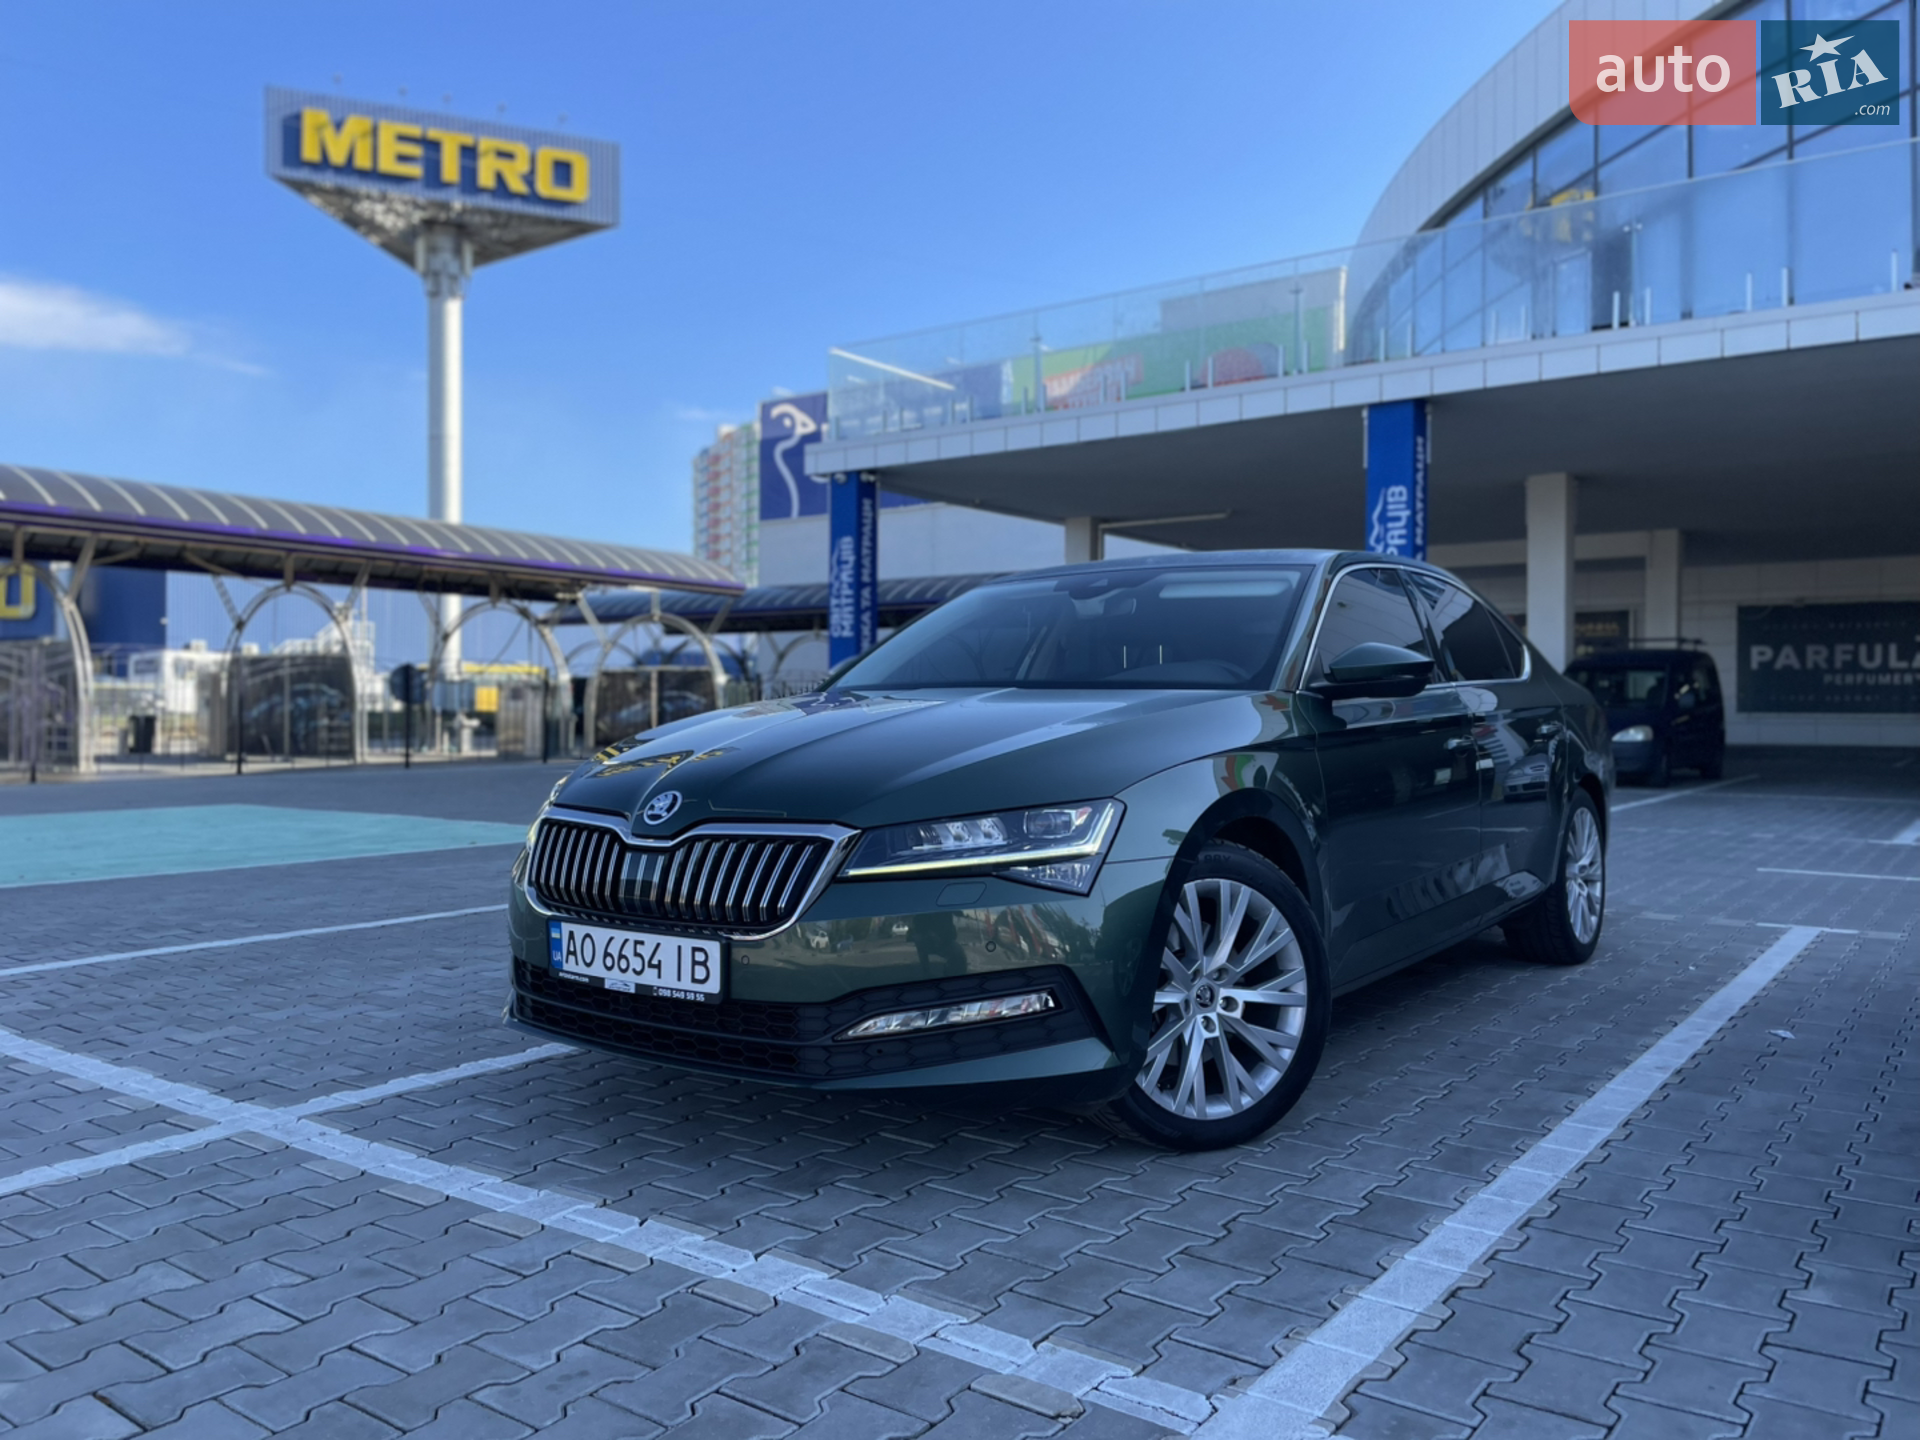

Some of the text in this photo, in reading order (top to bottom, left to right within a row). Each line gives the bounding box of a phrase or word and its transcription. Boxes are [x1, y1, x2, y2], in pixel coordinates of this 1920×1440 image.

[301, 107, 590, 204] METRO
[1824, 672, 1920, 686] PERFUMER
[553, 950, 562, 961] UA
[565, 930, 710, 985] AO 6654 IB
